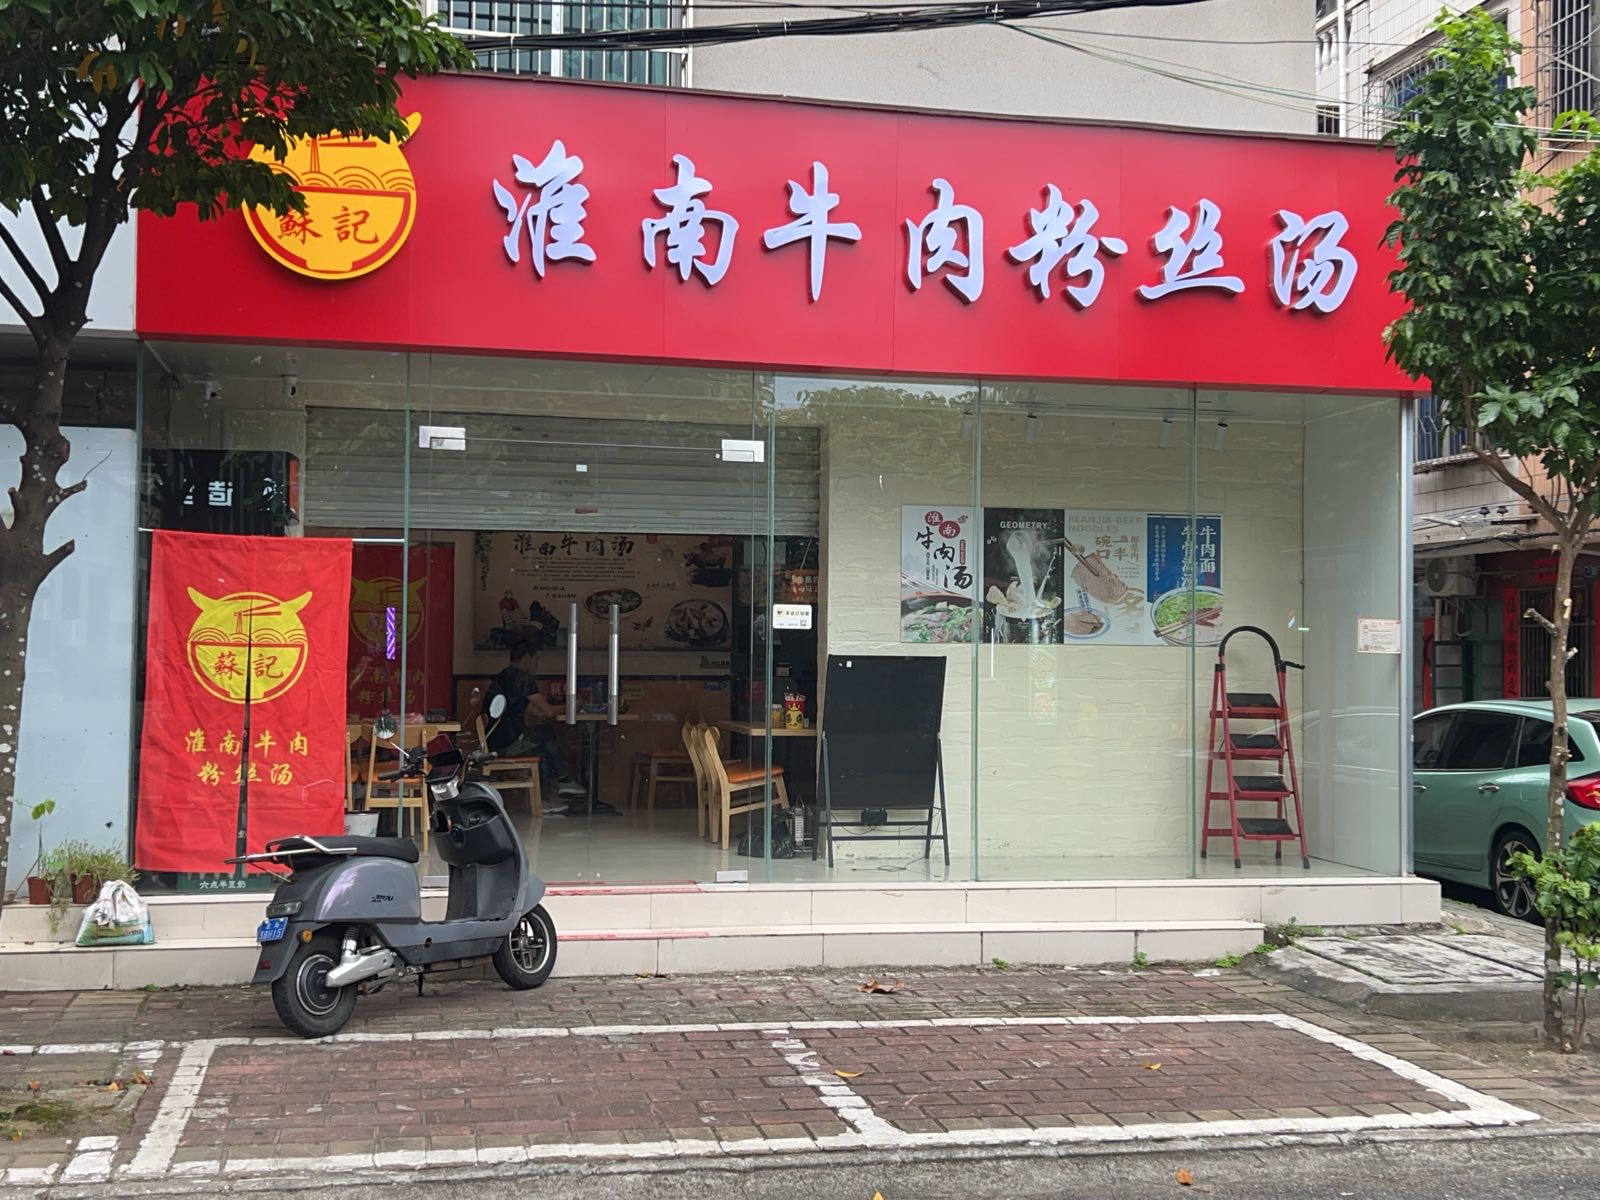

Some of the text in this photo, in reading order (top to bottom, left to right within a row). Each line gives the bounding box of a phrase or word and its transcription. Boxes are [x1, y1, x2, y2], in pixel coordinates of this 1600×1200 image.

[493, 140, 1357, 313] 淮南牛肉粉丝汤
[915, 526, 973, 589] 牛肉汤
[1199, 525, 1217, 573] 牛肉面
[213, 652, 284, 679] 蘇記
[185, 729, 309, 758] 淮南牛肉
[197, 762, 294, 786] 粉丝汤
